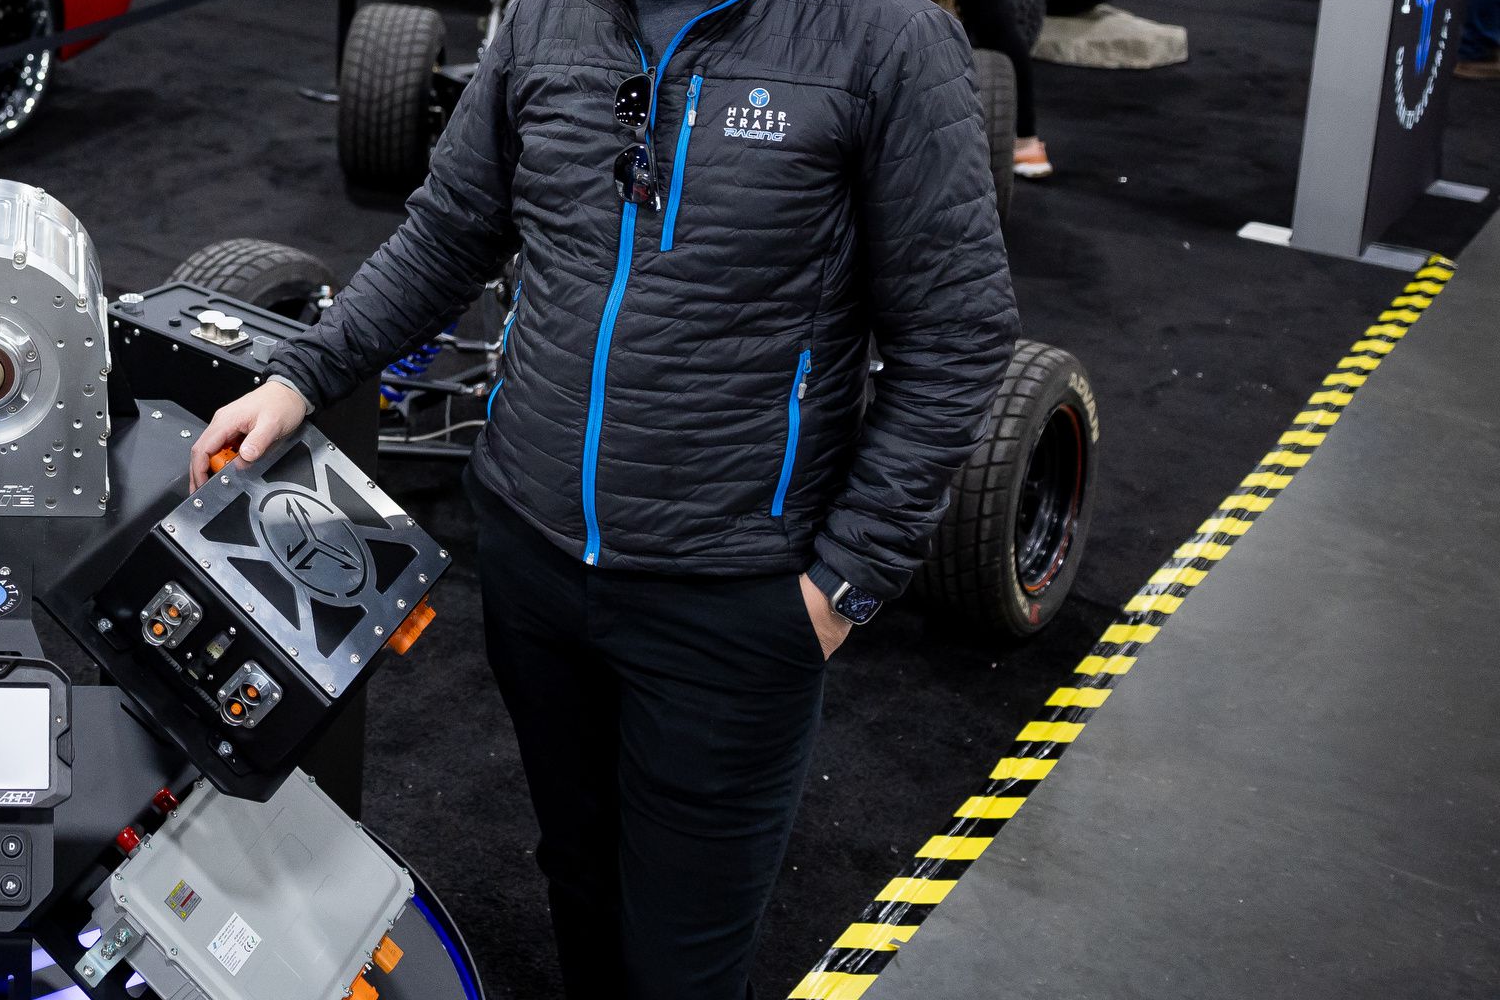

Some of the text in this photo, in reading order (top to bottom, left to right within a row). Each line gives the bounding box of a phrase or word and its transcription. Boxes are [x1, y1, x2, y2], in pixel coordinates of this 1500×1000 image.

[727, 107, 787, 121] HYPER
[726, 117, 786, 132] CRAFT
[723, 127, 786, 142] RACING
[8, 842, 16, 851] D
